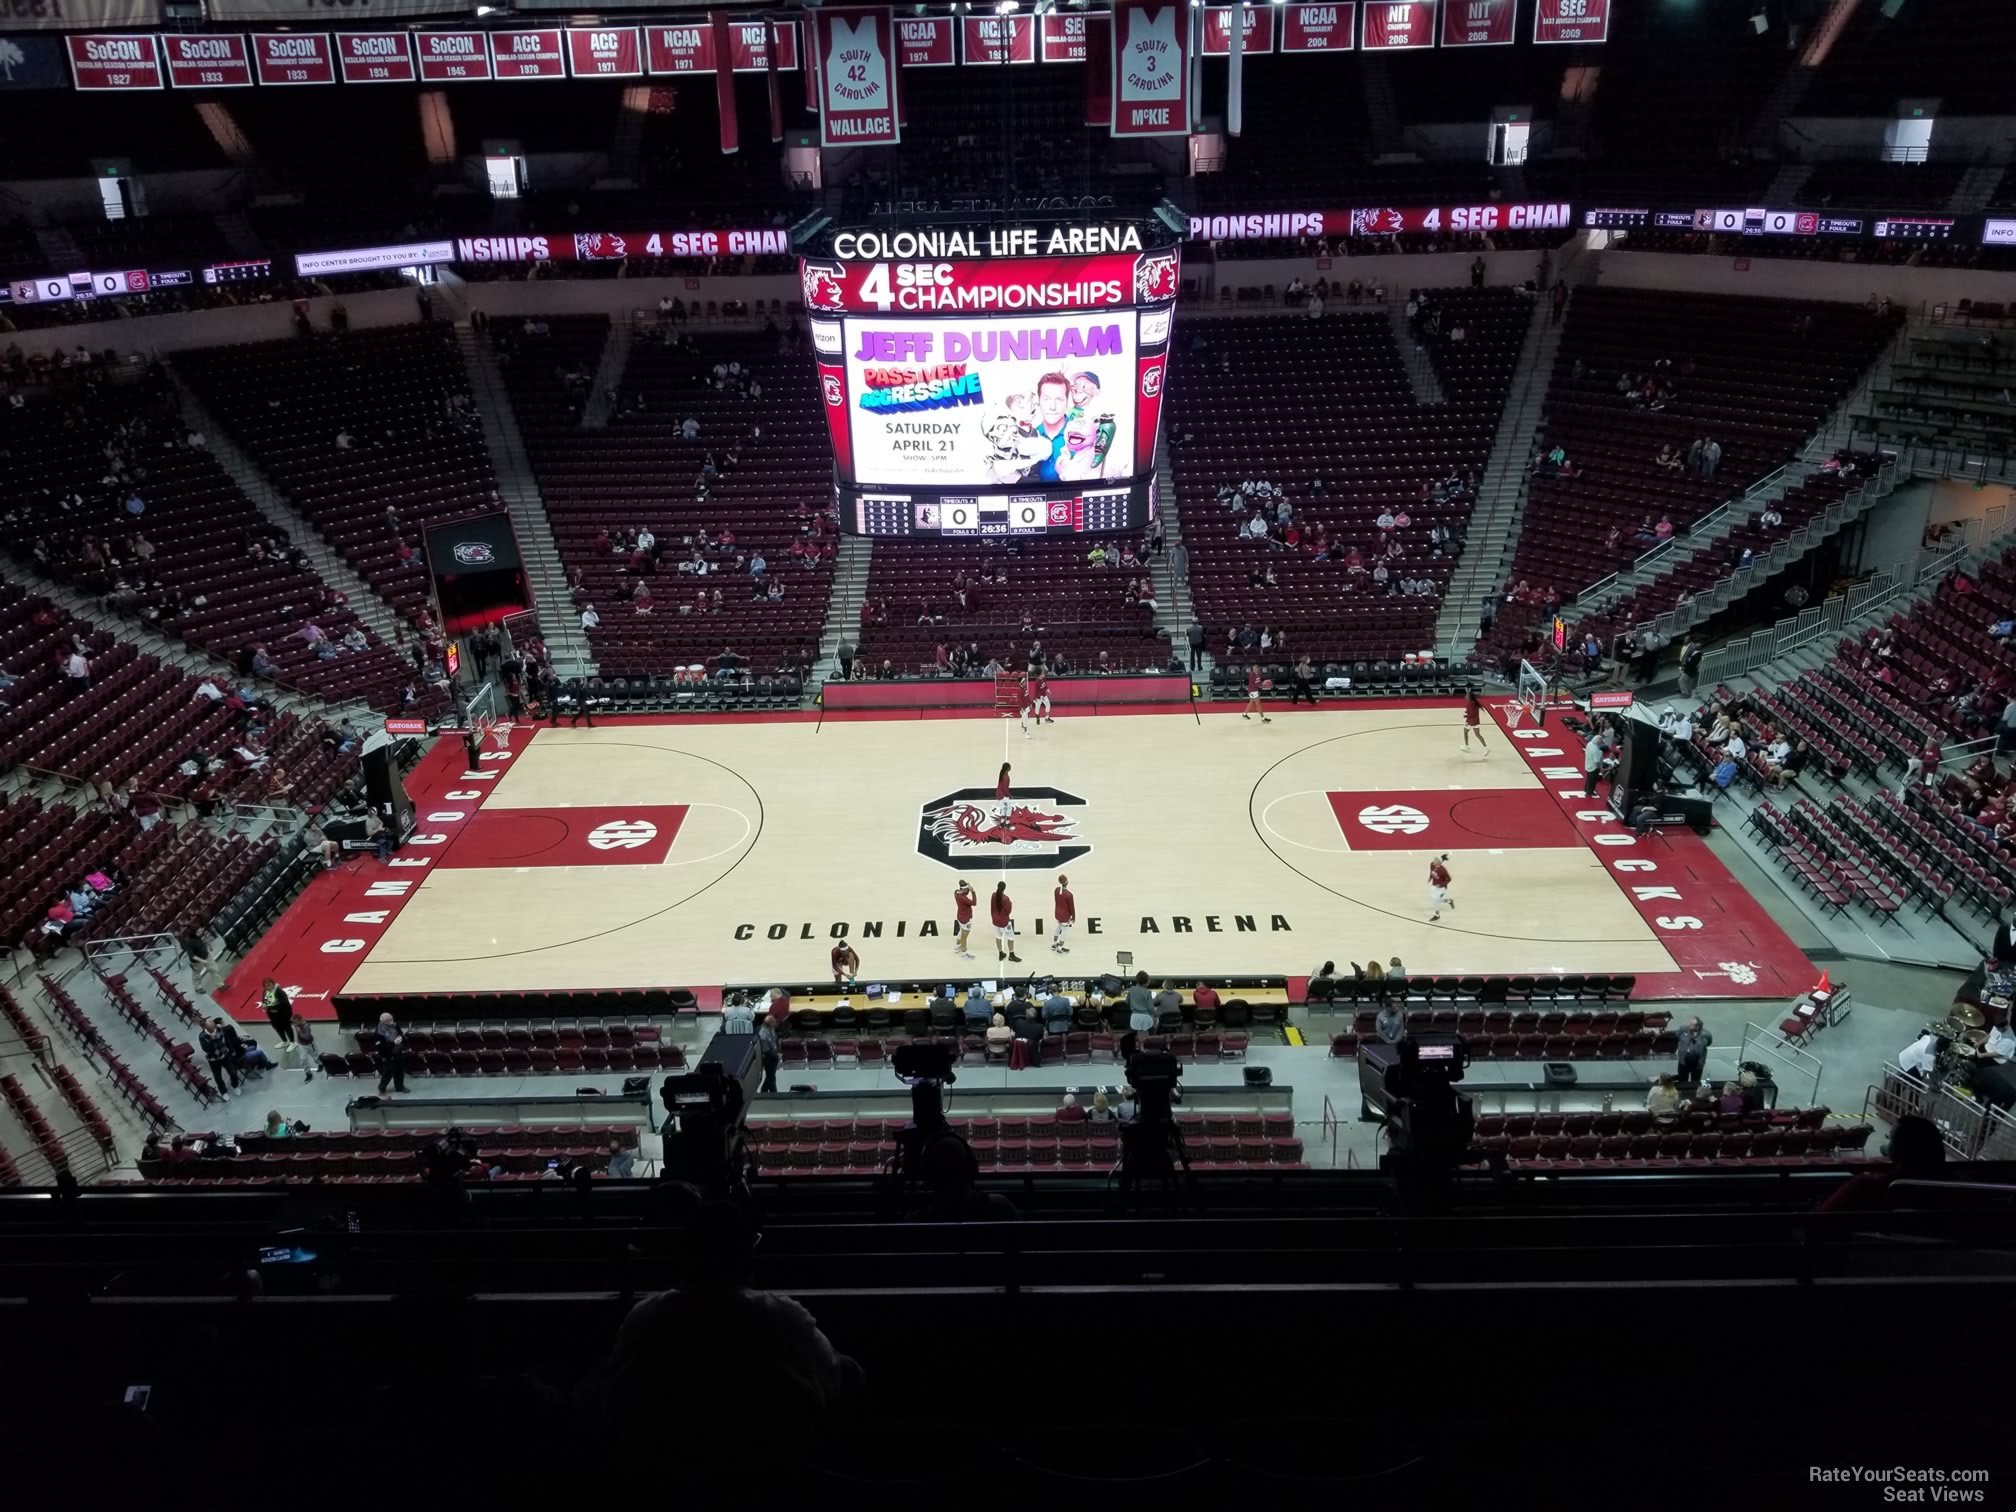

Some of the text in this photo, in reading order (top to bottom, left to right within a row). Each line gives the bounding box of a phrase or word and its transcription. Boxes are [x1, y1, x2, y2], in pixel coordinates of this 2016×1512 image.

[1300, 7, 1337, 25] NCAA
[1388, 5, 1411, 22] NIT
[1469, 2, 1491, 19] NIT
[1560, 0, 1586, 16] SEC
[664, 30, 701, 48] NCAA
[901, 22, 936, 40] NCAA
[1389, 35, 1408, 44] 2005
[1560, 29, 1580, 38] 2009
[86, 40, 141, 60] SoCON
[180, 40, 232, 59] SoCON
[269, 39, 316, 57] SoCON
[352, 37, 397, 55] SoCON
[430, 36, 474, 54] SoCON
[513, 36, 540, 52] ACC
[590, 33, 618, 50] ACC
[1136, 40, 1168, 54] SOUTH
[1307, 37, 1327, 48] 2004
[675, 59, 693, 69] 1971
[840, 49, 871, 63] SOUTH
[909, 52, 928, 62] 1974
[1147, 56, 1156, 72] 3
[369, 68, 389, 78] 1934
[447, 66, 466, 76] 1945
[520, 64, 539, 74] 1970
[597, 62, 616, 72] 1971
[848, 65, 866, 81] 42
[107, 74, 130, 85] 1927
[201, 72, 223, 82] 1933
[1128, 72, 1174, 90] CAROLINA
[834, 81, 880, 100] CAROLINA
[830, 117, 890, 136] WALLACE
[1191, 213, 1323, 240] PIONSHIPS
[1423, 208, 1440, 231] 4
[1451, 206, 1498, 230] SEC
[1723, 214, 1736, 228] 0
[1774, 216, 1786, 230] 0
[459, 237, 549, 262] NSHIPS
[645, 234, 664, 257] 4
[673, 233, 718, 256] SEC
[834, 226, 1142, 259] COLONIAL LIFE ARENA
[349, 256, 380, 264] BROUGHT
[104, 276, 116, 291] 0
[896, 264, 954, 287] SEC
[48, 282, 61, 296] 0
[859, 263, 896, 311] 4
[900, 280, 1122, 309] CHAMPIONSHIPS
[855, 325, 1123, 362] JEFF DUNHAM
[864, 363, 967, 387] PASSIVELY
[859, 372, 984, 413] AGGRESSIVE
[886, 423, 961, 434] SATURDAY
[892, 440, 955, 451] APRIL 21
[953, 509, 966, 525] 0
[1022, 508, 1035, 523] 0
[981, 525, 1007, 533] 26:36
[1512, 729, 1703, 930] GAMECOCKS
[320, 751, 512, 953] GAMECOCKS
[734, 920, 958, 940] COLONIA
[1140, 915, 1292, 934] ARENA
